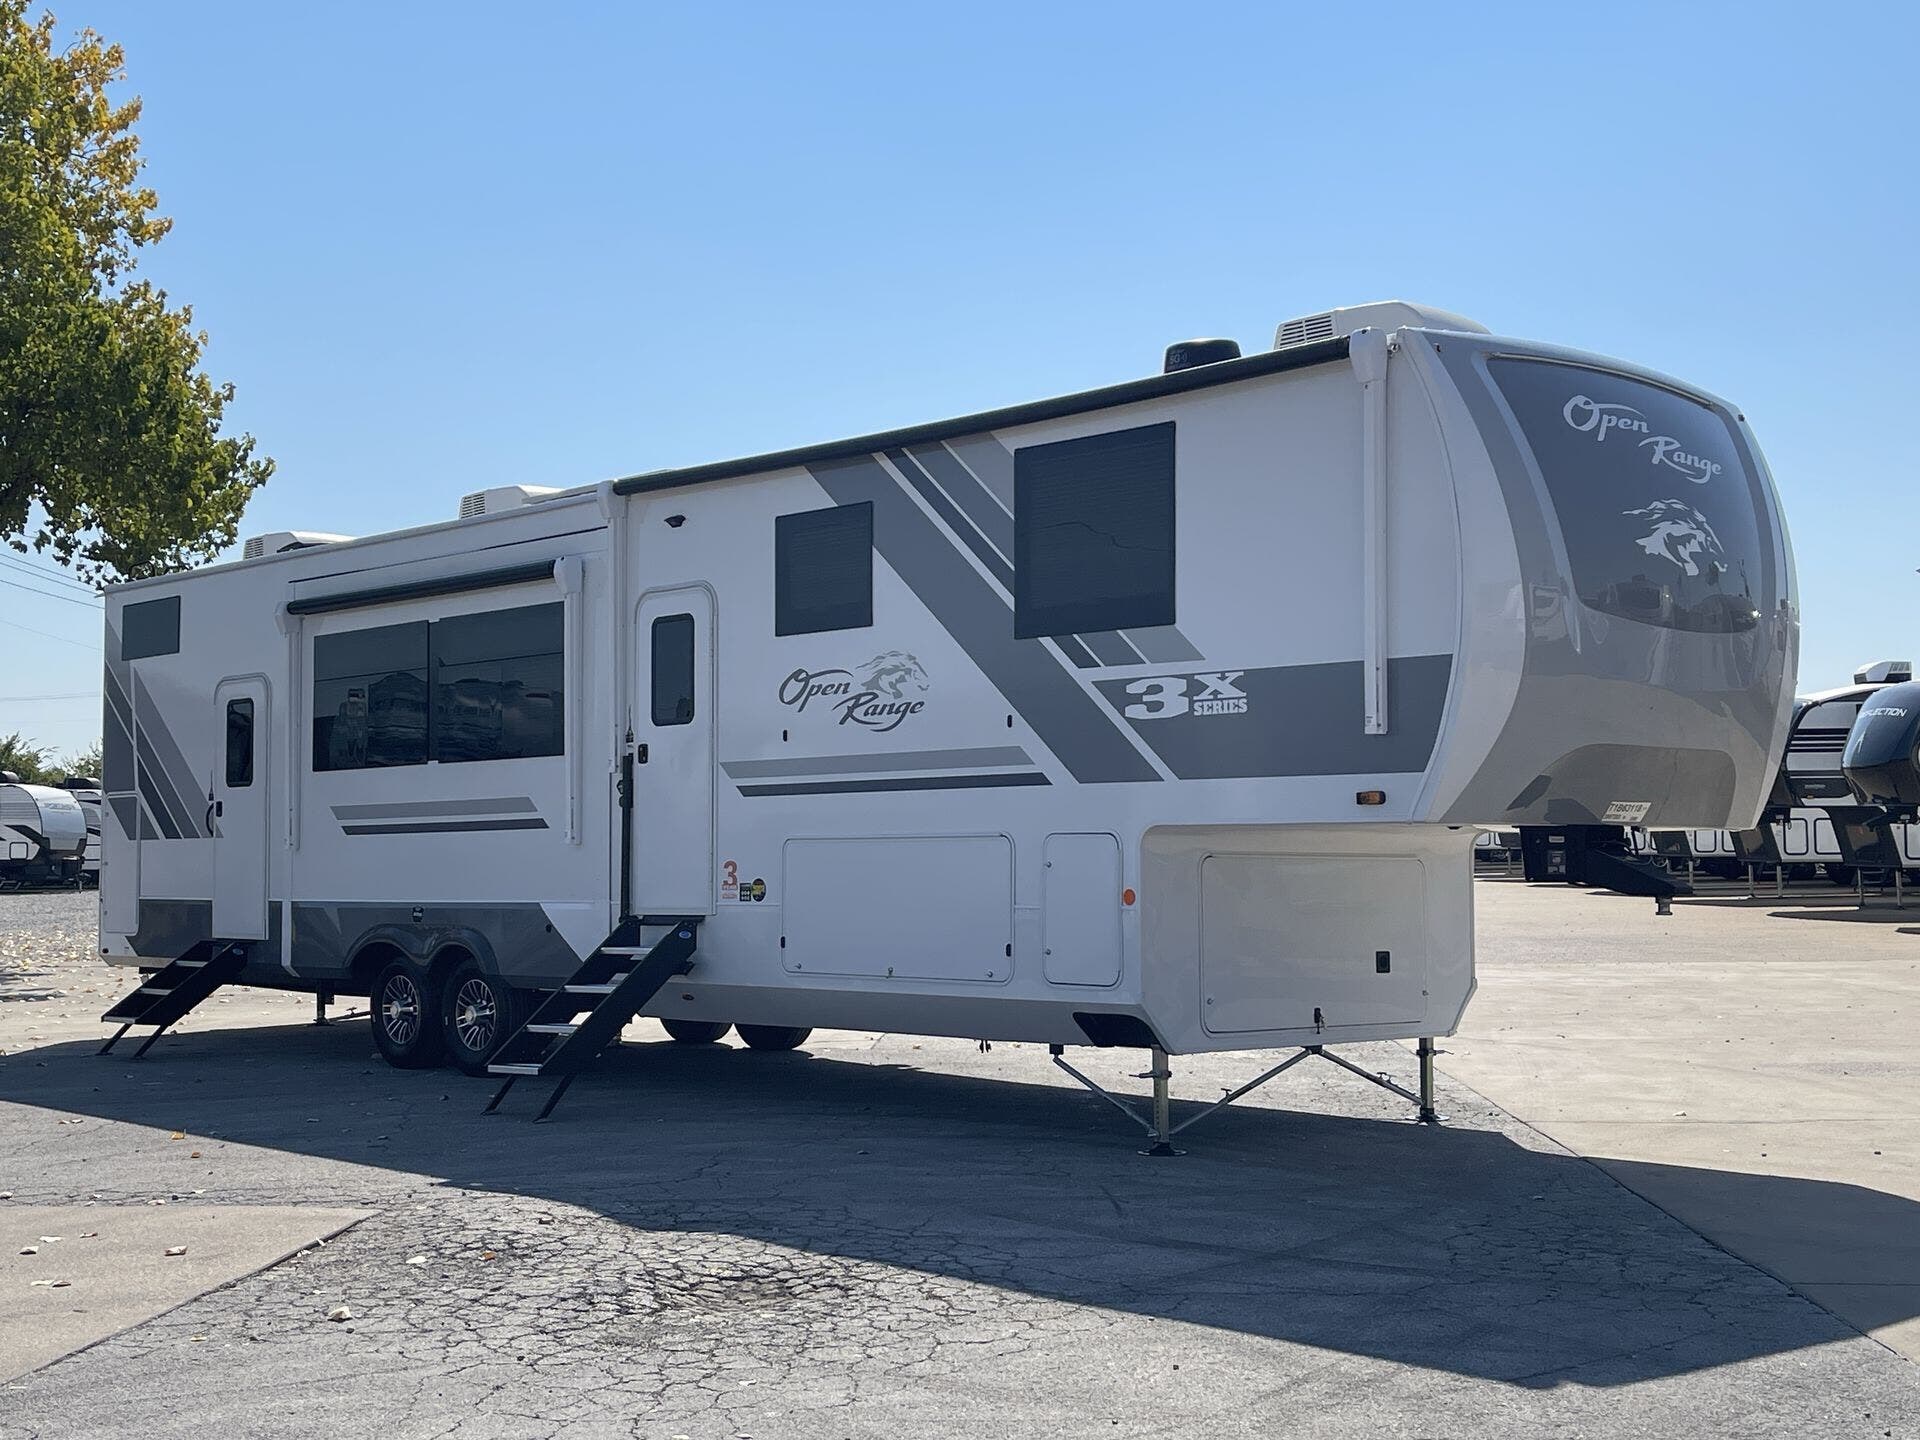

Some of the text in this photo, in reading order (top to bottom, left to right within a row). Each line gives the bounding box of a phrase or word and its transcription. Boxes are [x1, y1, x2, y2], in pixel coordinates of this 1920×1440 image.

[1563, 395, 1649, 441] Open
[1639, 436, 1722, 483] Range
[779, 668, 854, 713] Open
[832, 692, 925, 732] Range
[1193, 699, 1248, 716] SERIES
